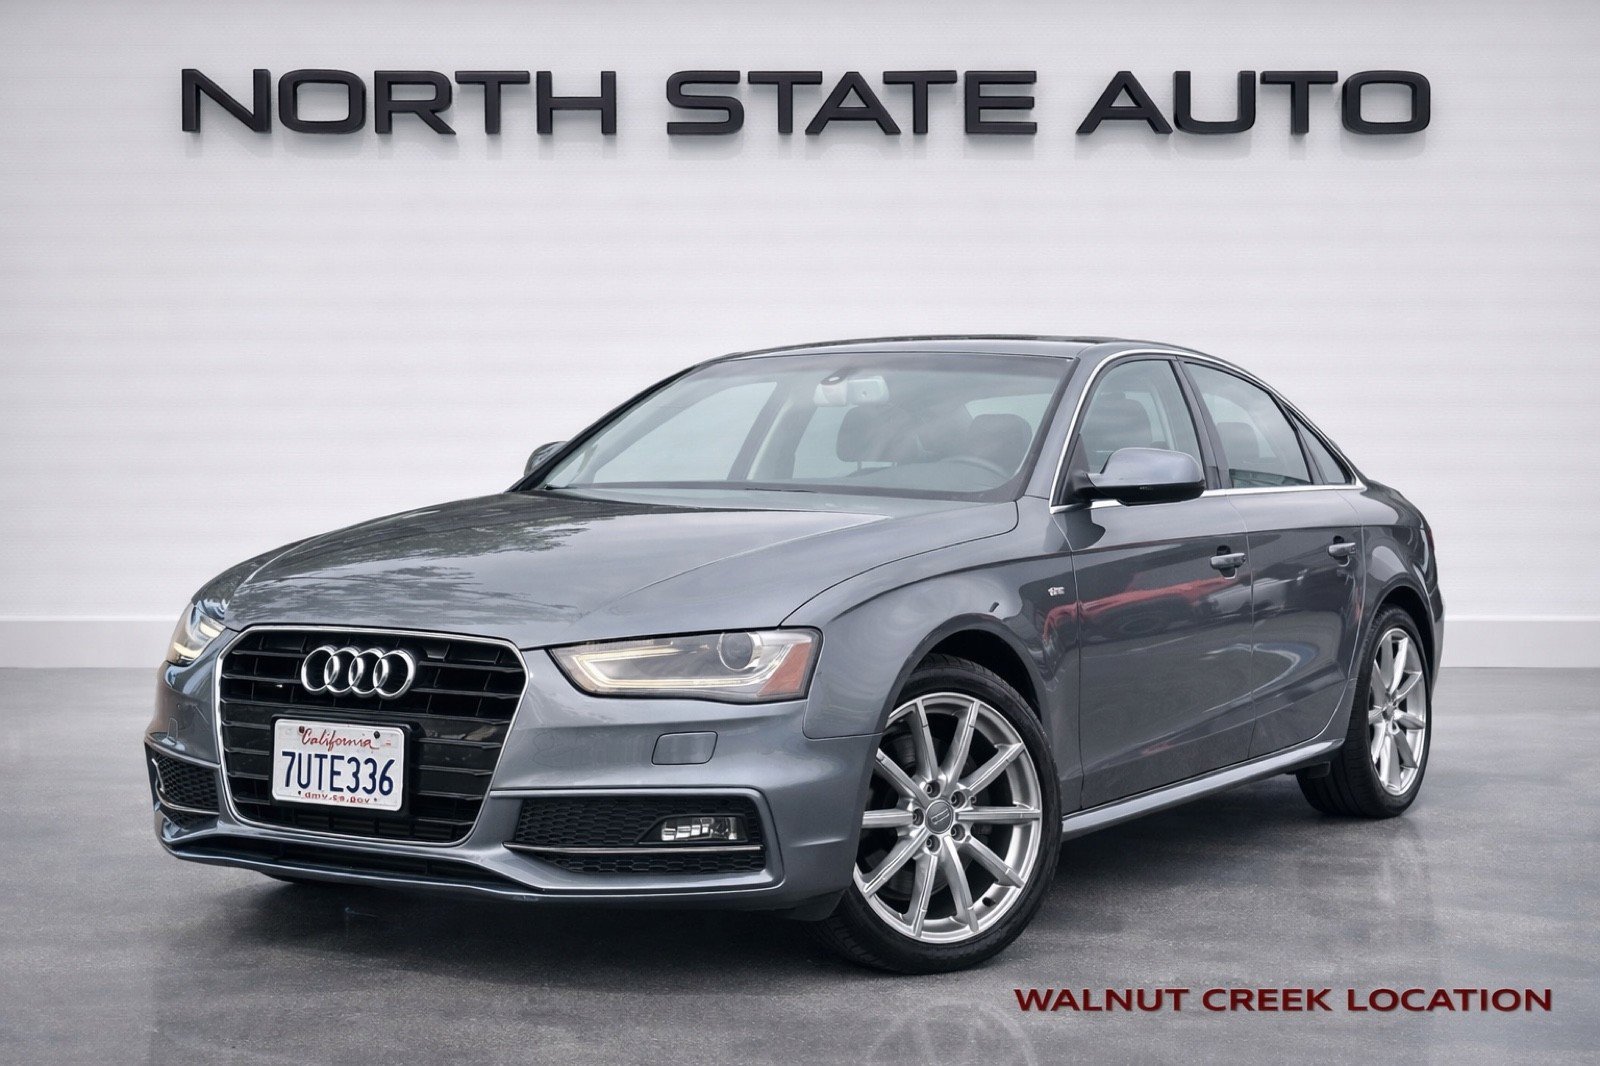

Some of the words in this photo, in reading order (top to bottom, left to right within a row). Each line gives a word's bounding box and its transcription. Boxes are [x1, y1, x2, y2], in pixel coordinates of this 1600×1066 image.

[182, 69, 617, 136] NORTH
[666, 70, 1038, 136] STATE
[1076, 70, 1431, 136] AUTO
[301, 727, 380, 752] California
[281, 750, 396, 796] 7UTE336
